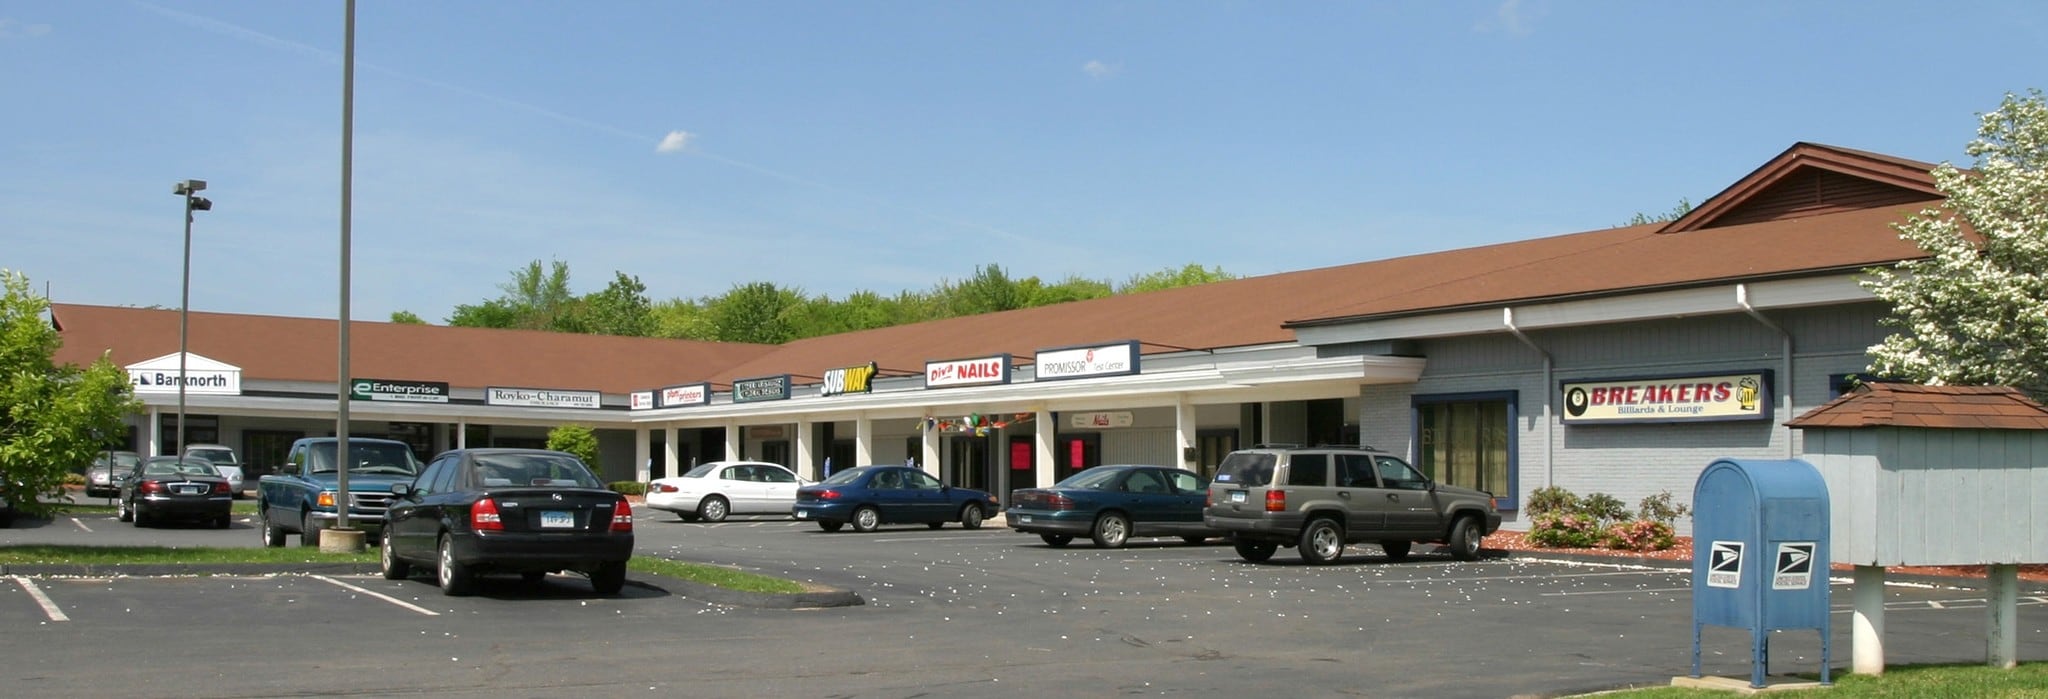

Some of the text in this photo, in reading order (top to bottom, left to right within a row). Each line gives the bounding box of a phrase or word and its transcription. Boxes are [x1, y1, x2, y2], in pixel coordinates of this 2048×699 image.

[957, 362, 999, 379] NAILS
[1044, 360, 1086, 375] PROMISSOR
[155, 372, 227, 387] Banknorth
[821, 365, 873, 394] SUBWAY
[373, 382, 440, 394] Enterprise
[1590, 381, 1734, 407] BREAKERS
[495, 389, 593, 403] Royko-Charamut
[1617, 404, 1704, 415] Billiards & Lounge
